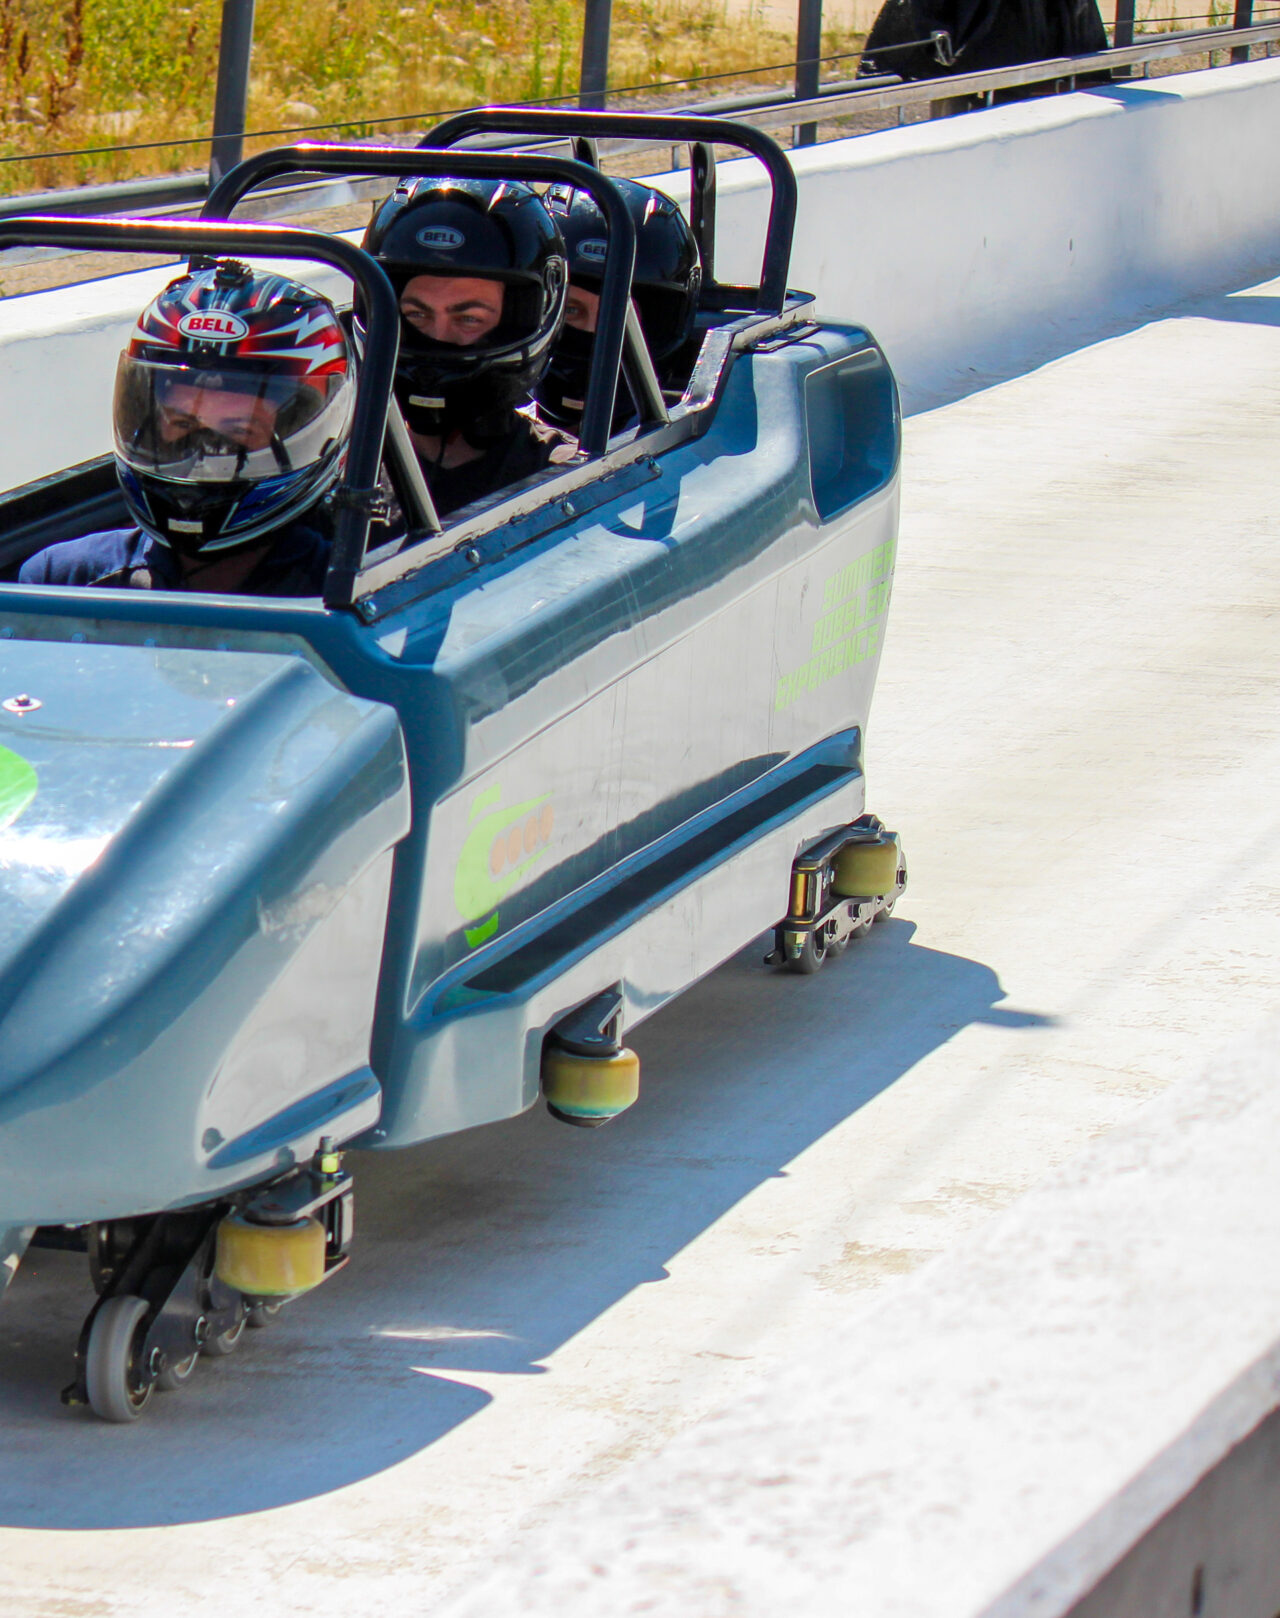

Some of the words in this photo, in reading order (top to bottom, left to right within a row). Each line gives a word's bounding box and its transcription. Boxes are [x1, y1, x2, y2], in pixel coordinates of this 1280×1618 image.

[422, 231, 457, 244] BELL
[583, 244, 607, 257] BEL
[187, 317, 237, 335] BELL
[823, 538, 896, 613] SUMMER
[812, 580, 890, 654] BOBSLED
[774, 623, 881, 713] EXPERIENCE
